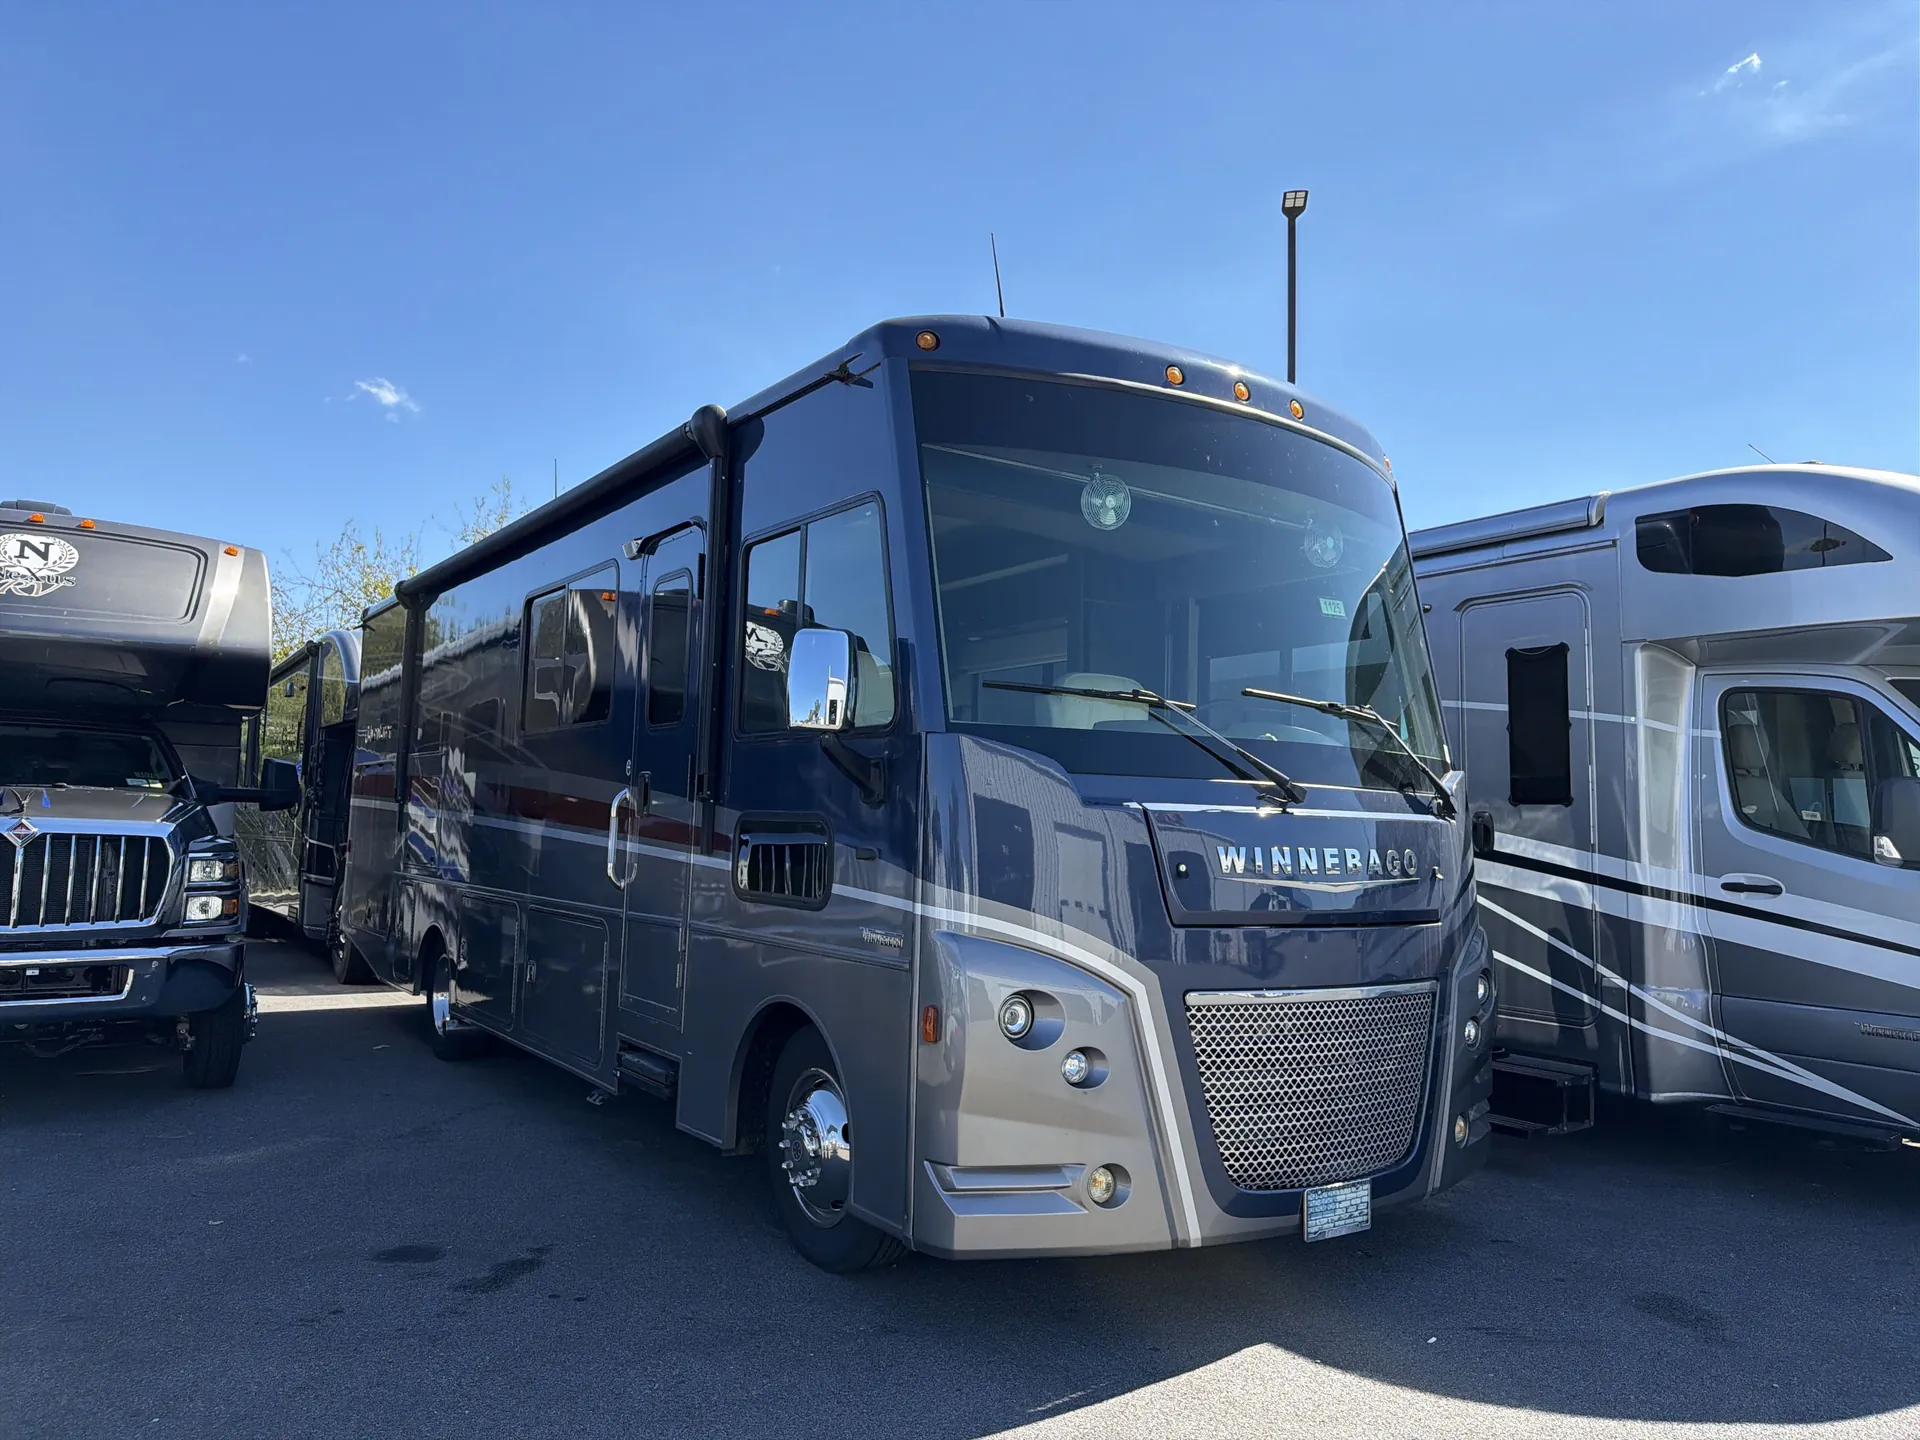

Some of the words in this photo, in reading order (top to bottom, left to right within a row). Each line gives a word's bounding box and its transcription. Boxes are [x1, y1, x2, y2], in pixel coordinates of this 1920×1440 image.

[14, 539, 55, 562] N
[1323, 600, 1342, 614] 1125
[1216, 846, 1418, 876] WINNEBAGO
